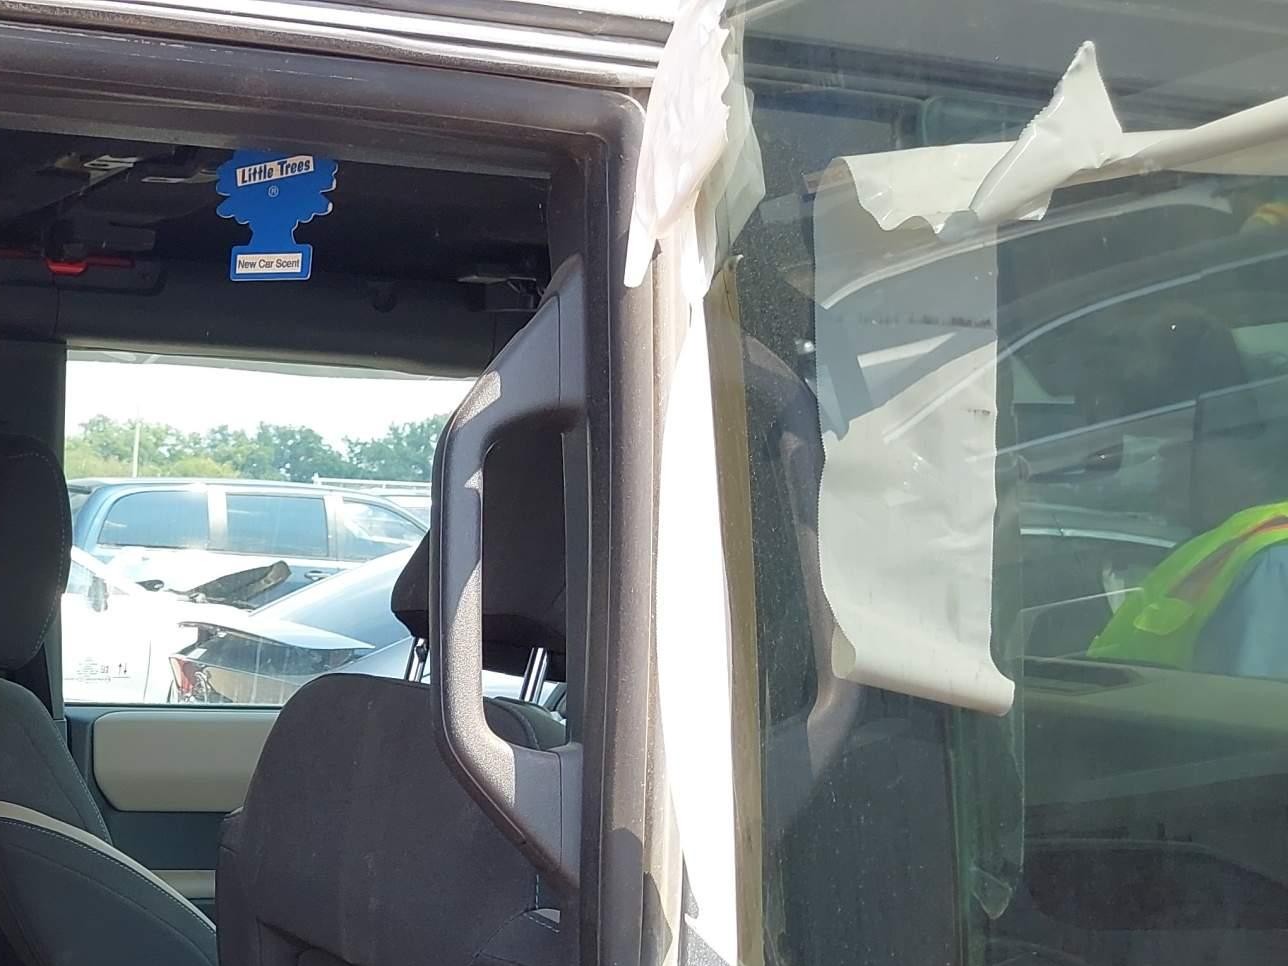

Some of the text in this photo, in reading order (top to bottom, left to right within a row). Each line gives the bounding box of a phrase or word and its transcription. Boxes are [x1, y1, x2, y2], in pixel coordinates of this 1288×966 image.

[240, 159, 311, 184] Little Trees
[237, 258, 300, 269] New Car Scent
